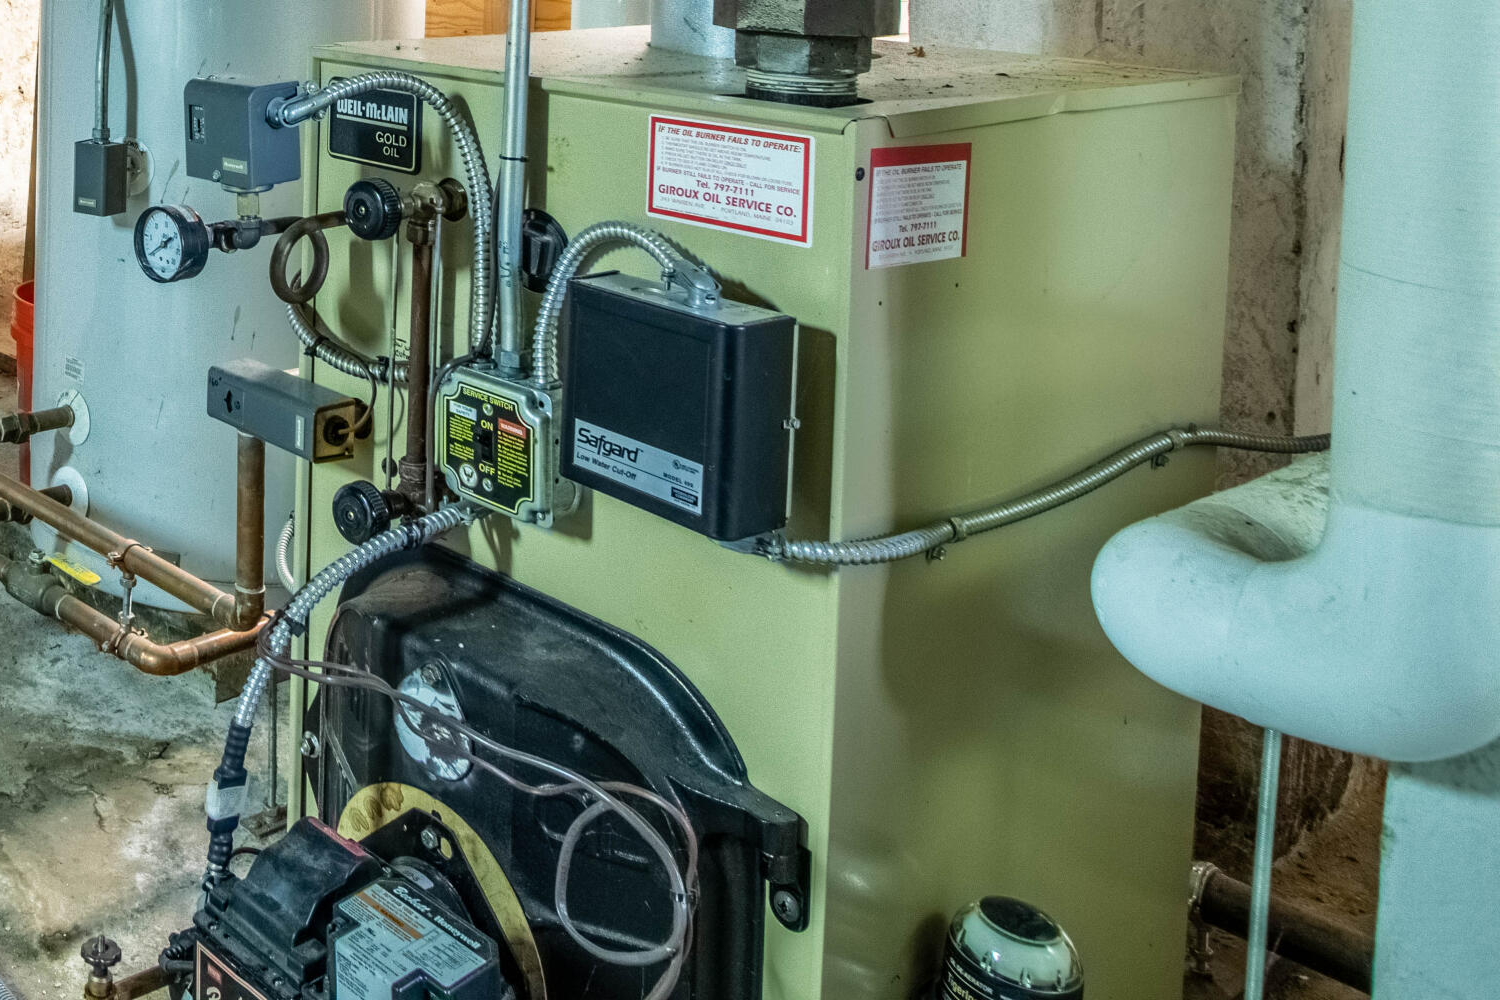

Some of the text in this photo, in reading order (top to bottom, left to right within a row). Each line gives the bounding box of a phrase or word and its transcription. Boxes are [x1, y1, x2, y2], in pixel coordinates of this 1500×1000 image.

[376, 132, 406, 147] GOLD
[658, 125, 666, 133] IF
[667, 127, 681, 136] THE
[682, 129, 693, 138] OIL
[696, 131, 726, 142] BURNER
[727, 136, 749, 145] FAILS
[751, 139, 762, 147] TO
[763, 141, 801, 153] OPERATE:
[383, 146, 399, 157] OIL
[696, 180, 754, 196] Tel. 797-7111
[658, 184, 699, 200] GIROUX
[703, 192, 722, 204] OIL
[725, 196, 772, 213] SERVICE
[776, 205, 797, 218] CO.
[899, 221, 937, 233] Tel. 797-7111
[872, 230, 960, 252] GIROUX OIL SERVICE CO.
[462, 388, 513, 411] SERVICE SWITCH
[481, 420, 494, 431] ON
[577, 427, 639, 463] Safgard
[479, 463, 495, 476] OFF
[576, 452, 636, 480] Low Water Cut-Off
[434, 915, 482, 949] Honeywell
